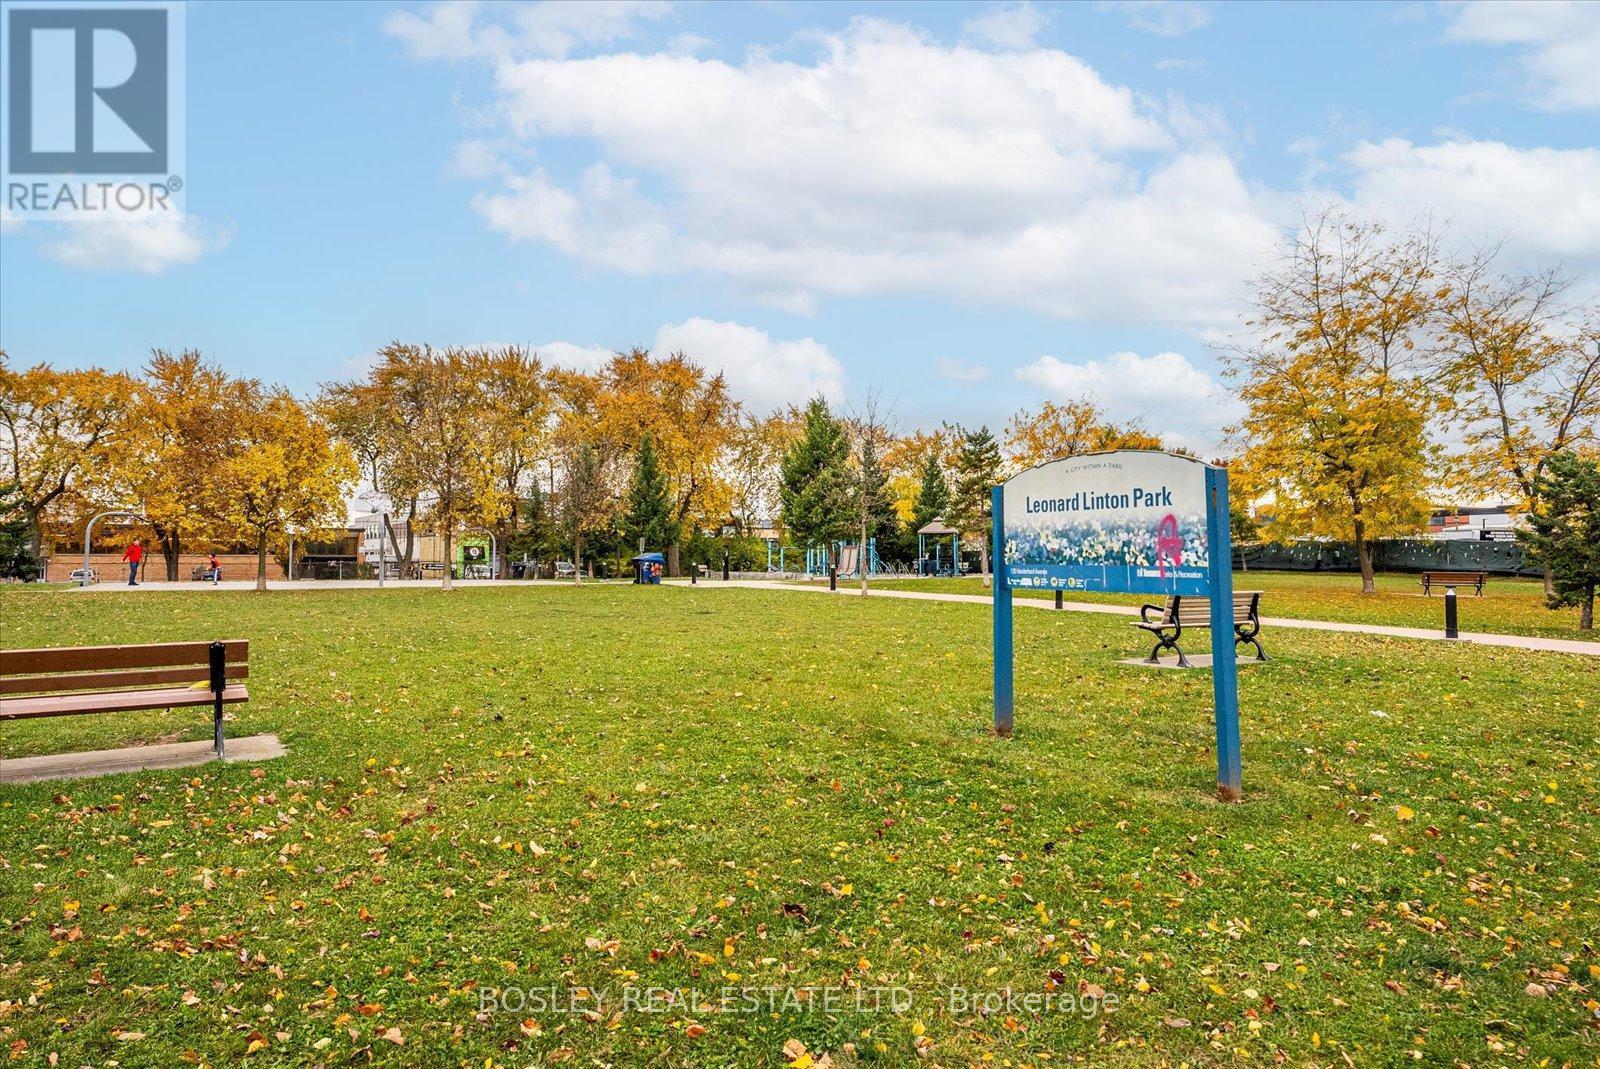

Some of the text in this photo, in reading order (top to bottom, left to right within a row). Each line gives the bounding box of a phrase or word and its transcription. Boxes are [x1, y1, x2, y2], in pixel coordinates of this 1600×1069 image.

[1070, 465, 1082, 473] CITY
[1108, 462, 1123, 470] PARK
[1026, 486, 1173, 514] Leonard Linton Park
